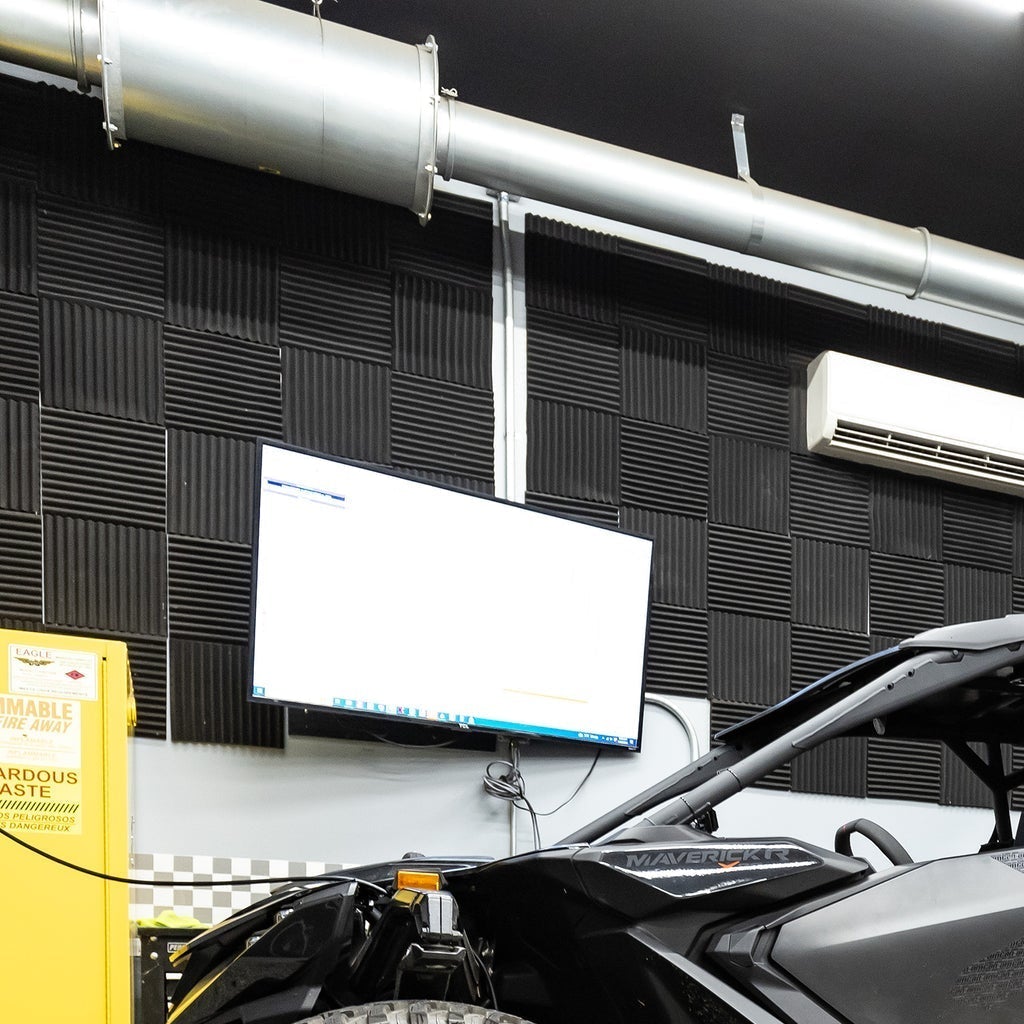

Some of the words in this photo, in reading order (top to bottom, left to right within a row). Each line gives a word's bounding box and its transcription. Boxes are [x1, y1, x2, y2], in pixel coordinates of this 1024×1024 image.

[15, 648, 51, 659] EAGLE
[0, 697, 73, 720] MABLE
[30, 719, 73, 734] AWAY
[0, 783, 51, 799] ASTE
[12, 813, 76, 824] PELIGROSOS
[9, 822, 71, 832] DANGEREUX
[626, 850, 759, 868] MAVERICK
[764, 849, 790, 861] R
